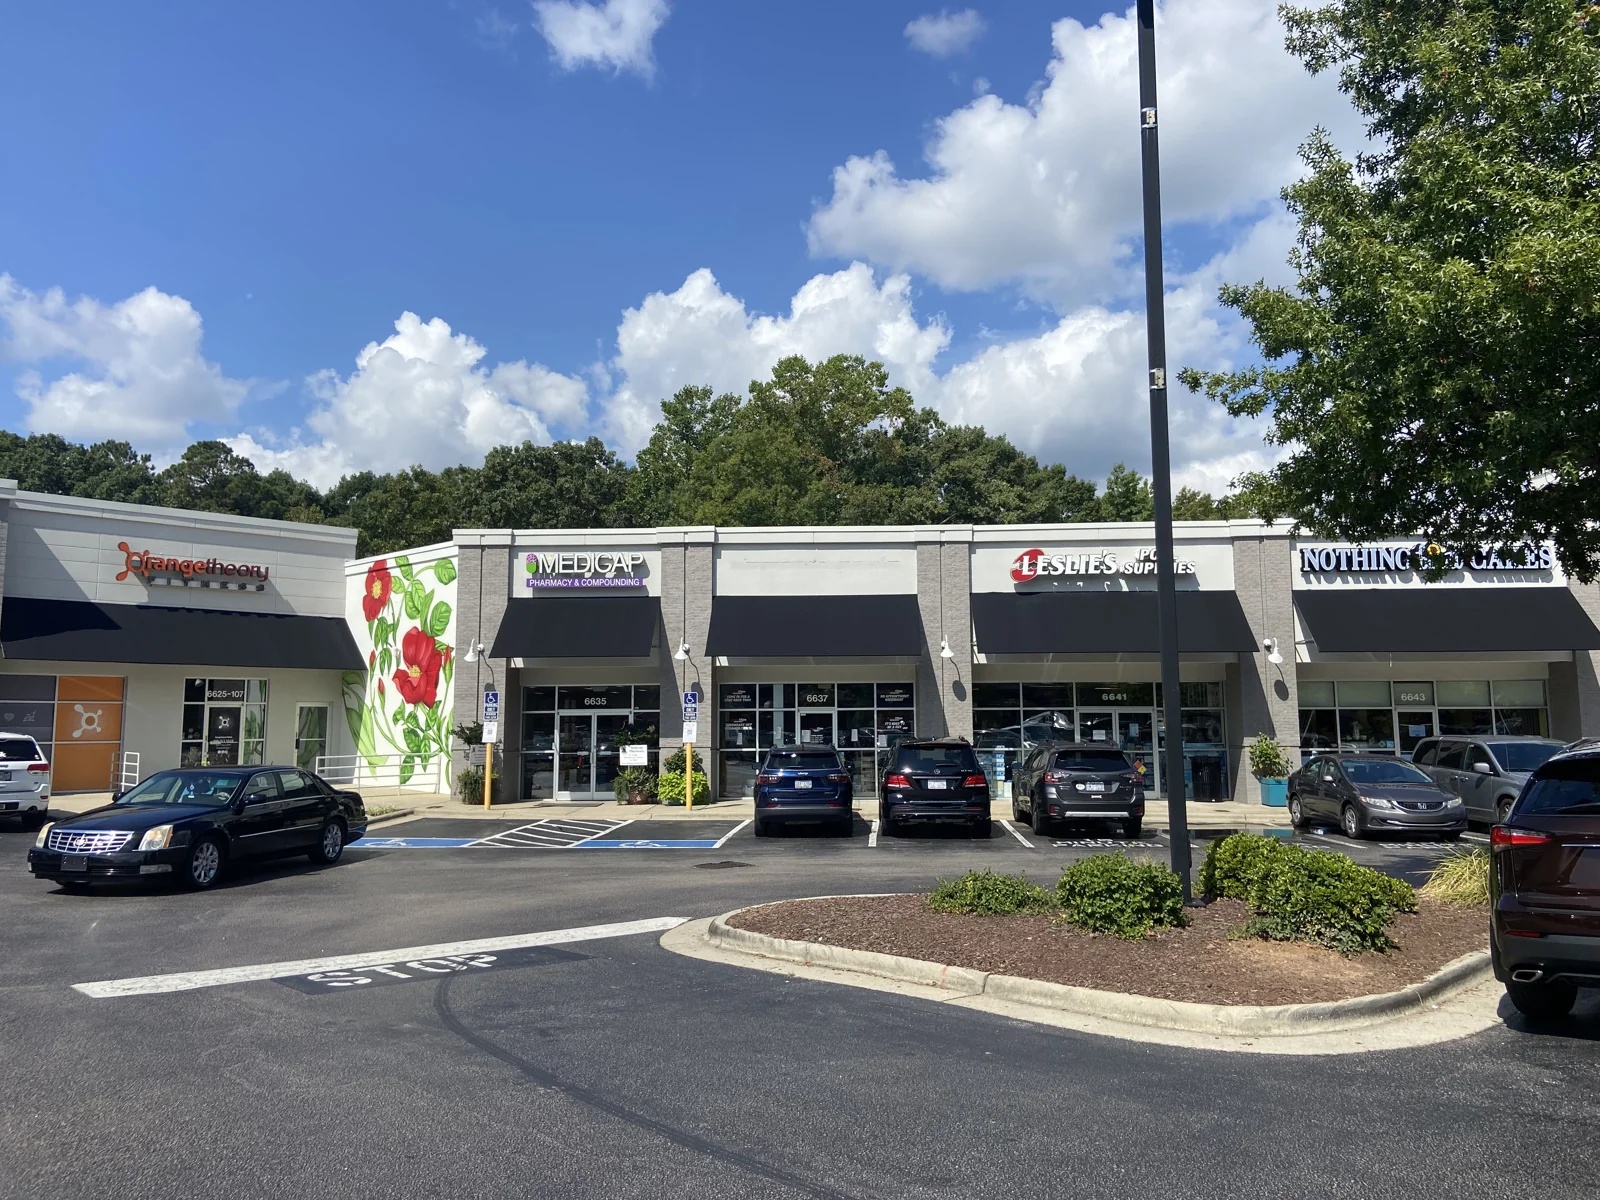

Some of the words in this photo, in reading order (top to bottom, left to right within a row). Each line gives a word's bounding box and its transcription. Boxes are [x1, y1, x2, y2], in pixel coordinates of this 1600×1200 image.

[1140, 548, 1178, 560] PO
[116, 542, 269, 582] Orangetheory
[539, 553, 644, 574] MEDICAP
[1021, 550, 1117, 575] LESLIE'S
[1124, 562, 1196, 574] SUPIES
[529, 579, 573, 587] PHARMACY
[574, 578, 580, 587] &
[581, 578, 640, 587] COMPOUNDING
[207, 690, 244, 698] 6625-107
[806, 694, 828, 702] 6637
[1401, 693, 1426, 701] 6643
[584, 697, 607, 705] 6635
[307, 954, 498, 987] STOP
